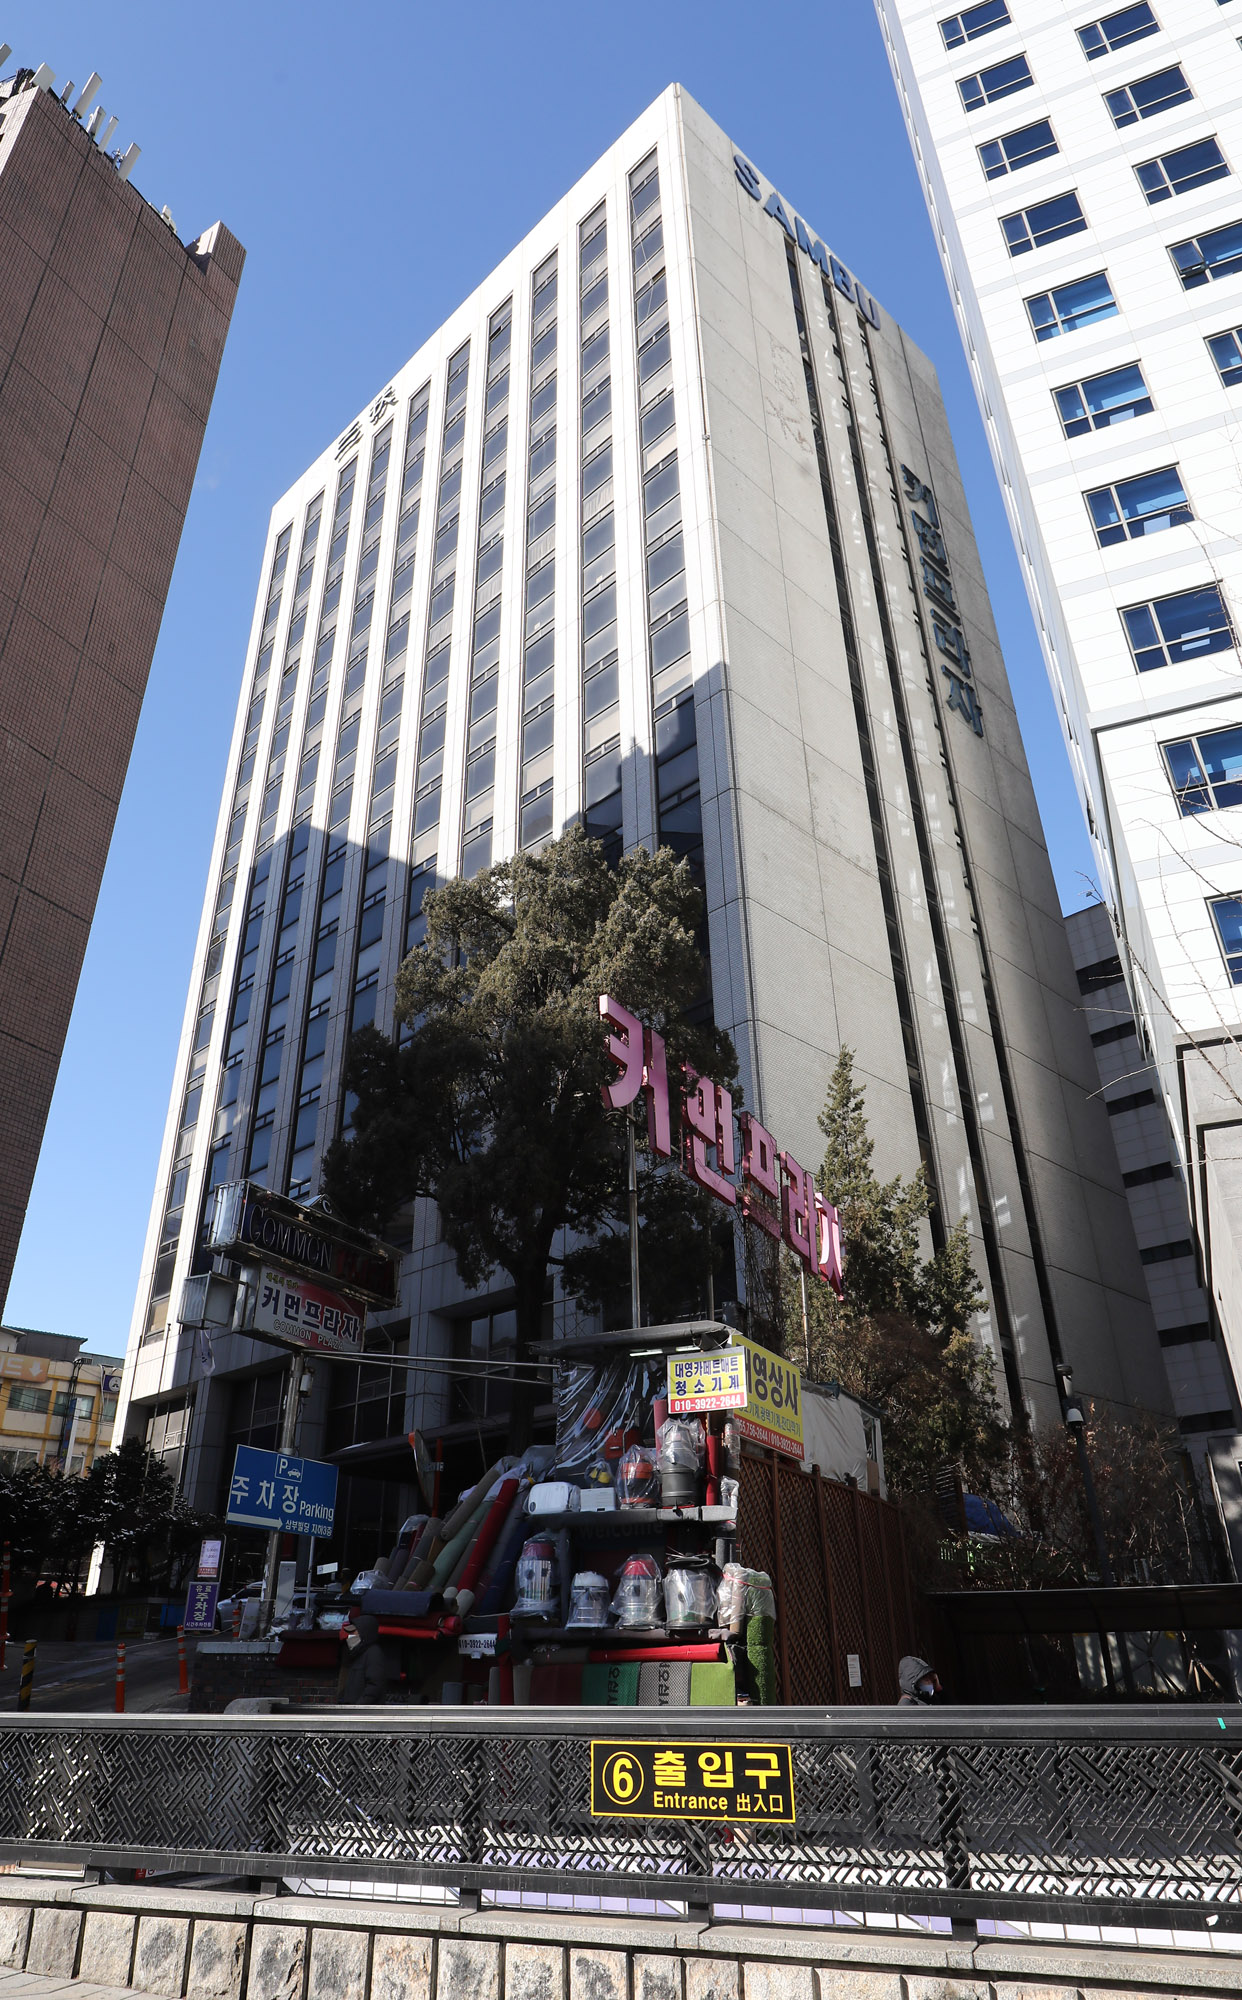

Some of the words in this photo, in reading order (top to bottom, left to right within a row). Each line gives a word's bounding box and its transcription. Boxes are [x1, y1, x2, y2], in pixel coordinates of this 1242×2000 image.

[734, 154, 881, 331] SAMBU
[262, 1285, 360, 1344] 커먼프라자
[273, 1318, 312, 1341] COMMON
[317, 1334, 344, 1352] PLAZA
[674, 1356, 739, 1379] 대영카페트매트
[675, 1374, 740, 1397] 청소기계
[674, 1394, 741, 1412] 010-3922-2644
[231, 1475, 299, 1514] 주차장
[299, 1502, 335, 1522] Parking
[285, 1519, 310, 1534] 삼부빌딩
[311, 1523, 333, 1537] 지하3층
[193, 1592, 209, 1621] 주차장
[653, 1750, 782, 1790] 출입구
[653, 1790, 728, 1811] Entrance
[736, 1792, 784, 1814] 出入口
